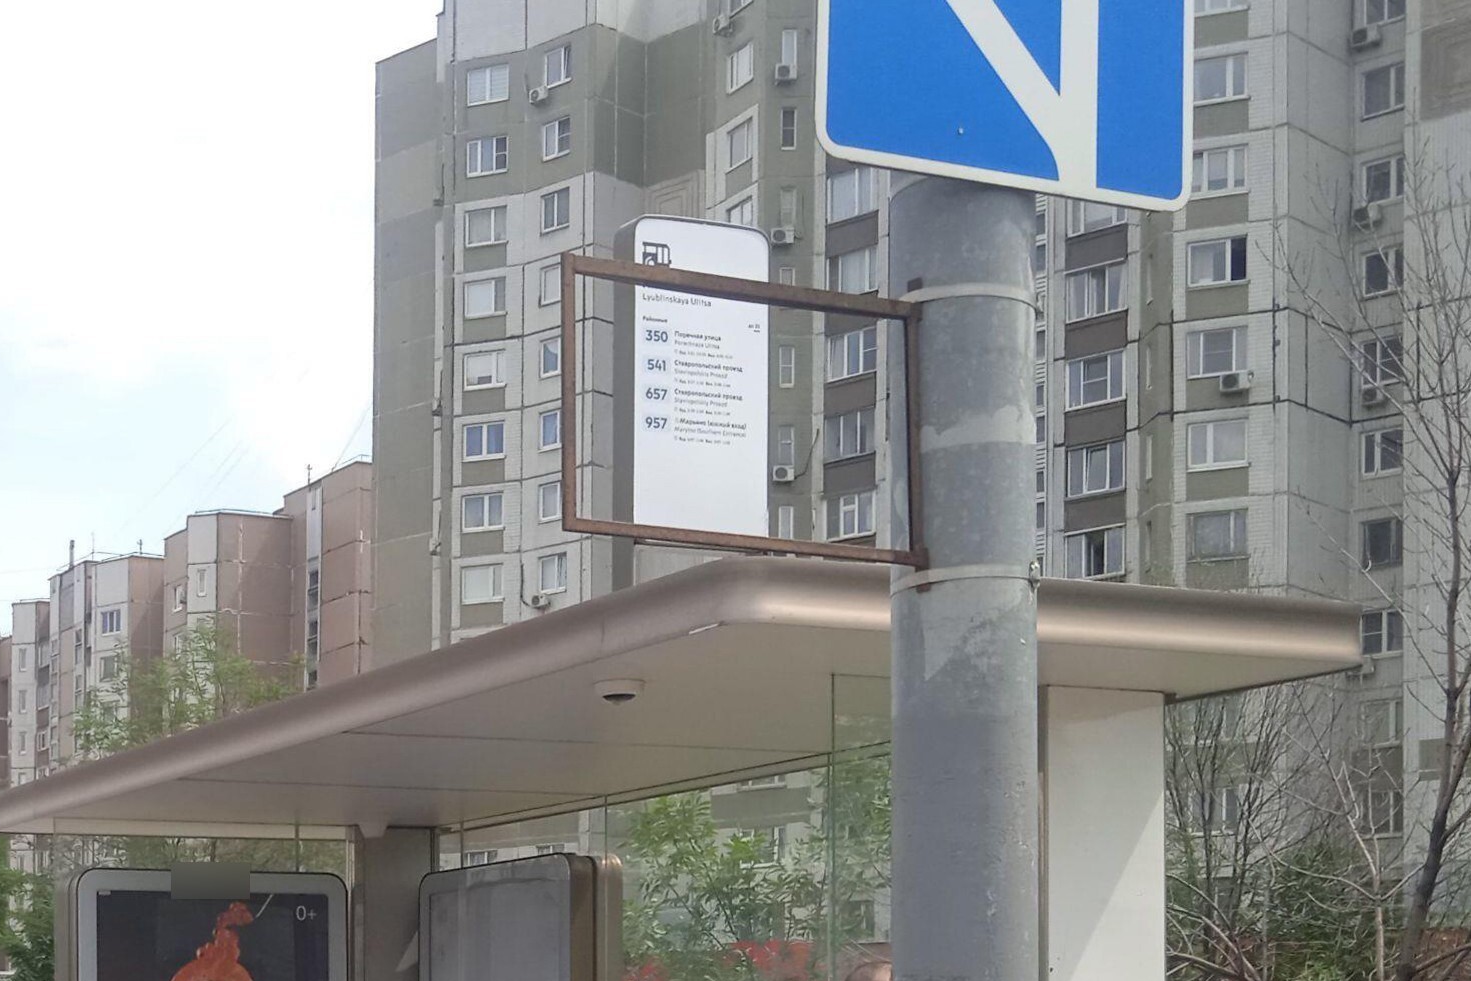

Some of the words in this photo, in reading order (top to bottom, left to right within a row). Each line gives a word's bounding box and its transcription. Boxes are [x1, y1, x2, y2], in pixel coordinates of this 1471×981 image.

[642, 293, 689, 307] Lyublinskaya
[690, 297, 712, 307] Ulitsa
[645, 329, 669, 343] 350
[647, 359, 667, 372] 541
[645, 387, 668, 401] 657
[645, 416, 668, 430] 957
[296, 905, 317, 921] 0+
